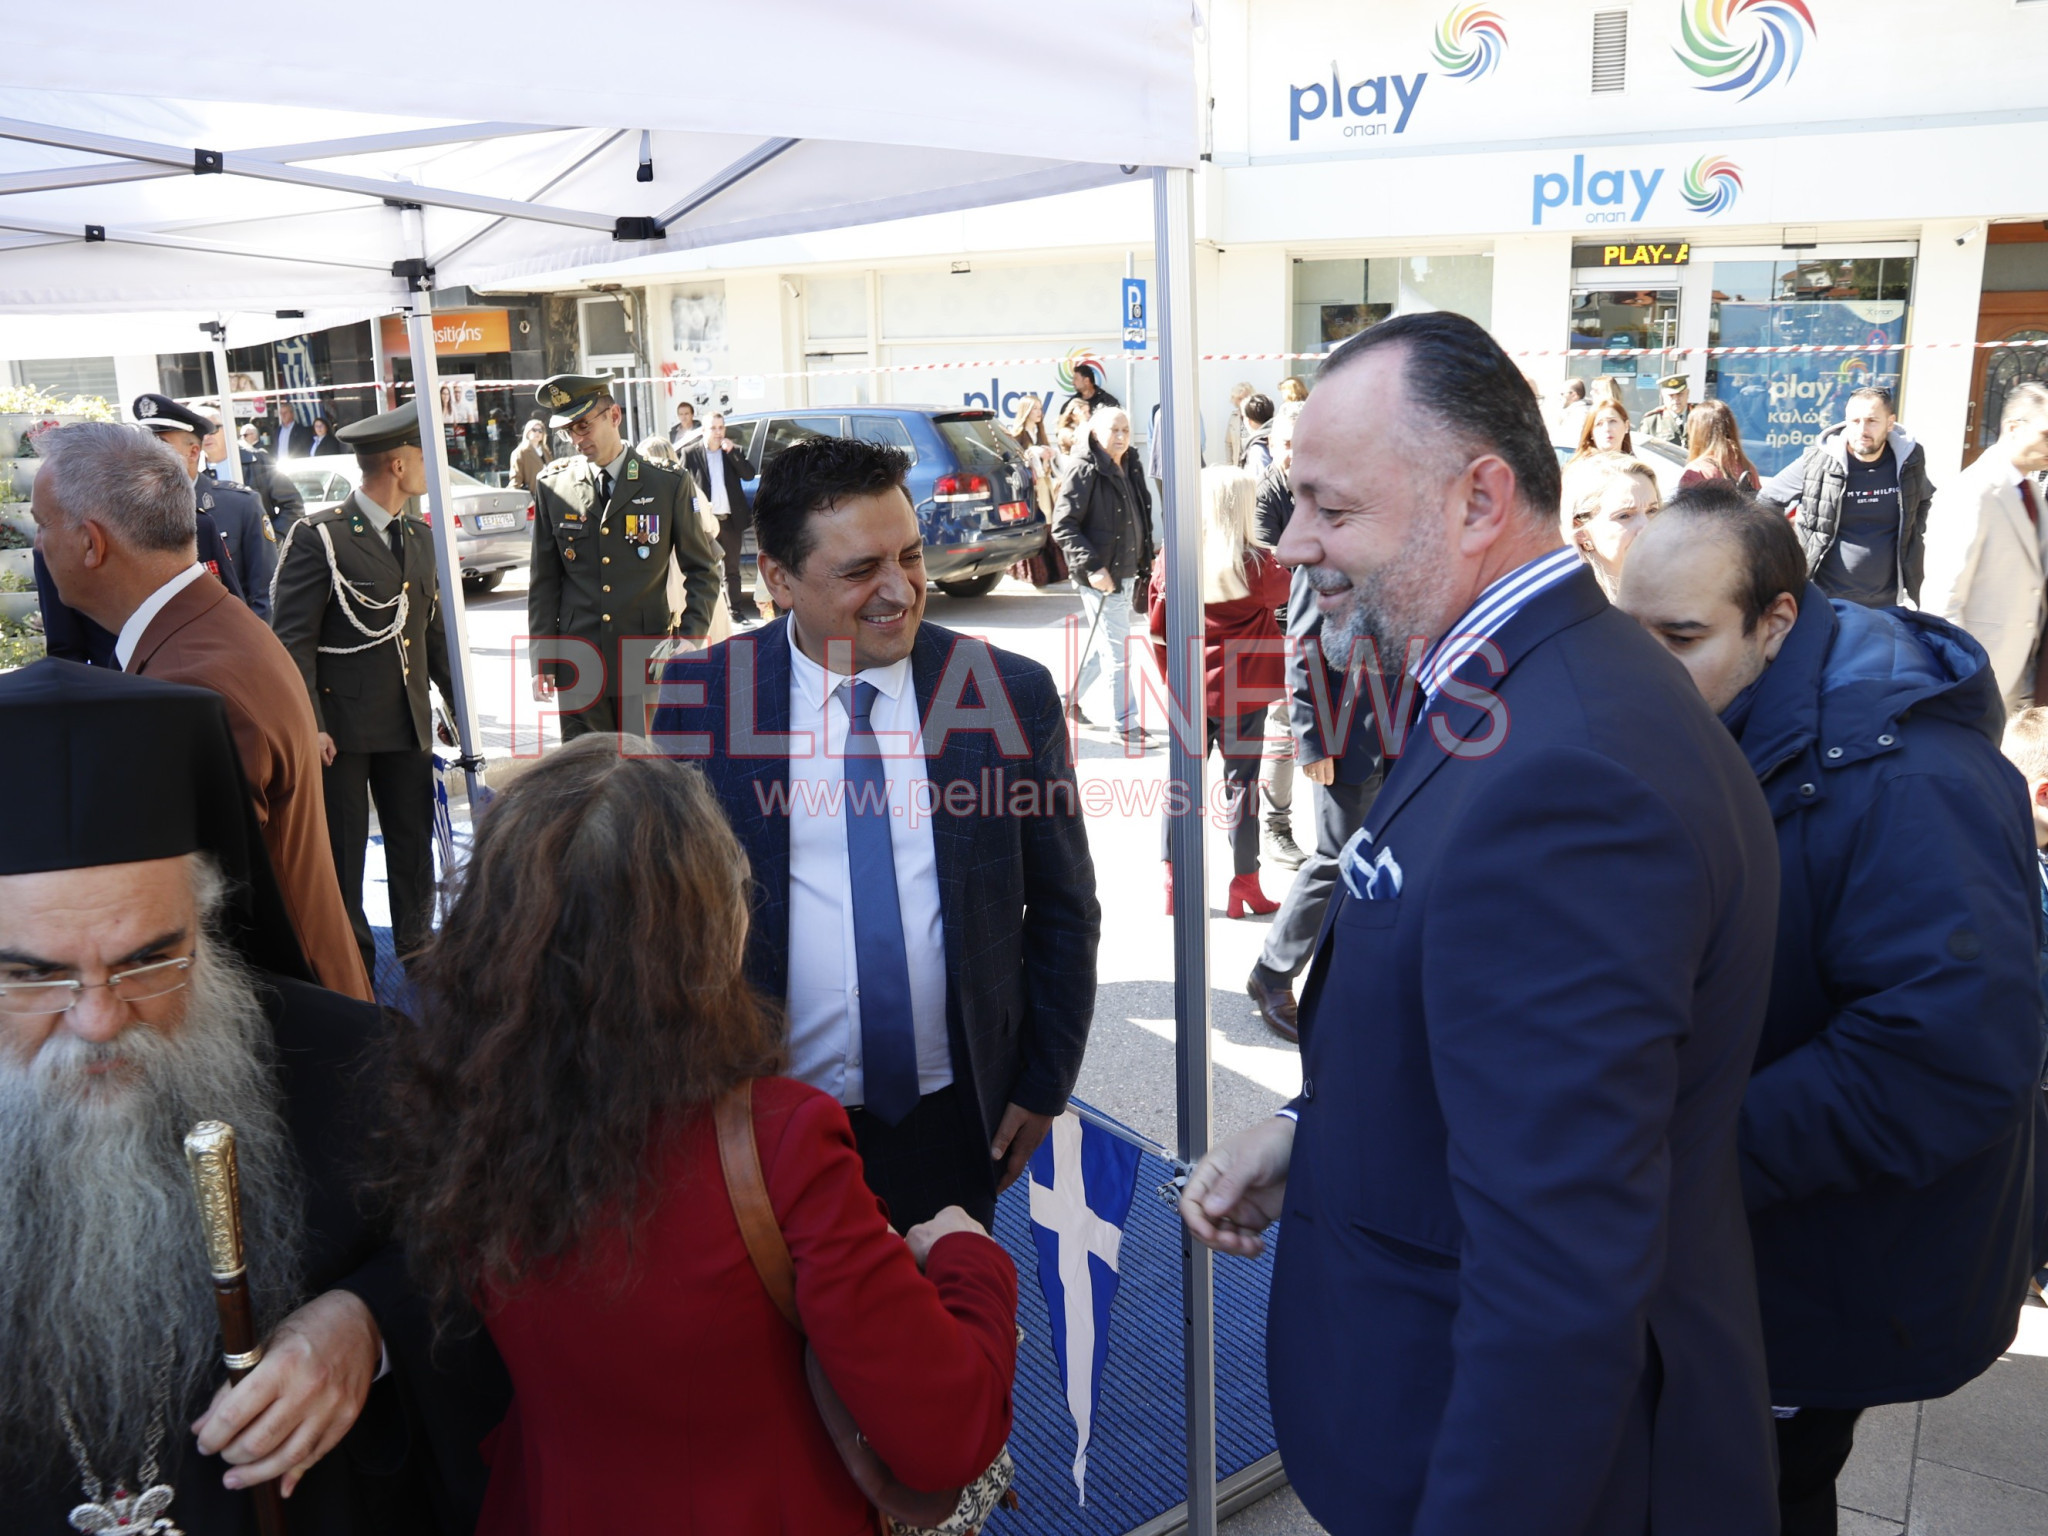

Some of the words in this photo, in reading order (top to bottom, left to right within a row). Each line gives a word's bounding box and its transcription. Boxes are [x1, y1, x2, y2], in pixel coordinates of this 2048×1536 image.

[1290, 60, 1429, 141] play
[1532, 154, 1665, 225] play
[1127, 285, 1142, 321] P
[1769, 373, 1834, 407] play
[1767, 407, 1832, 430] καλώς
